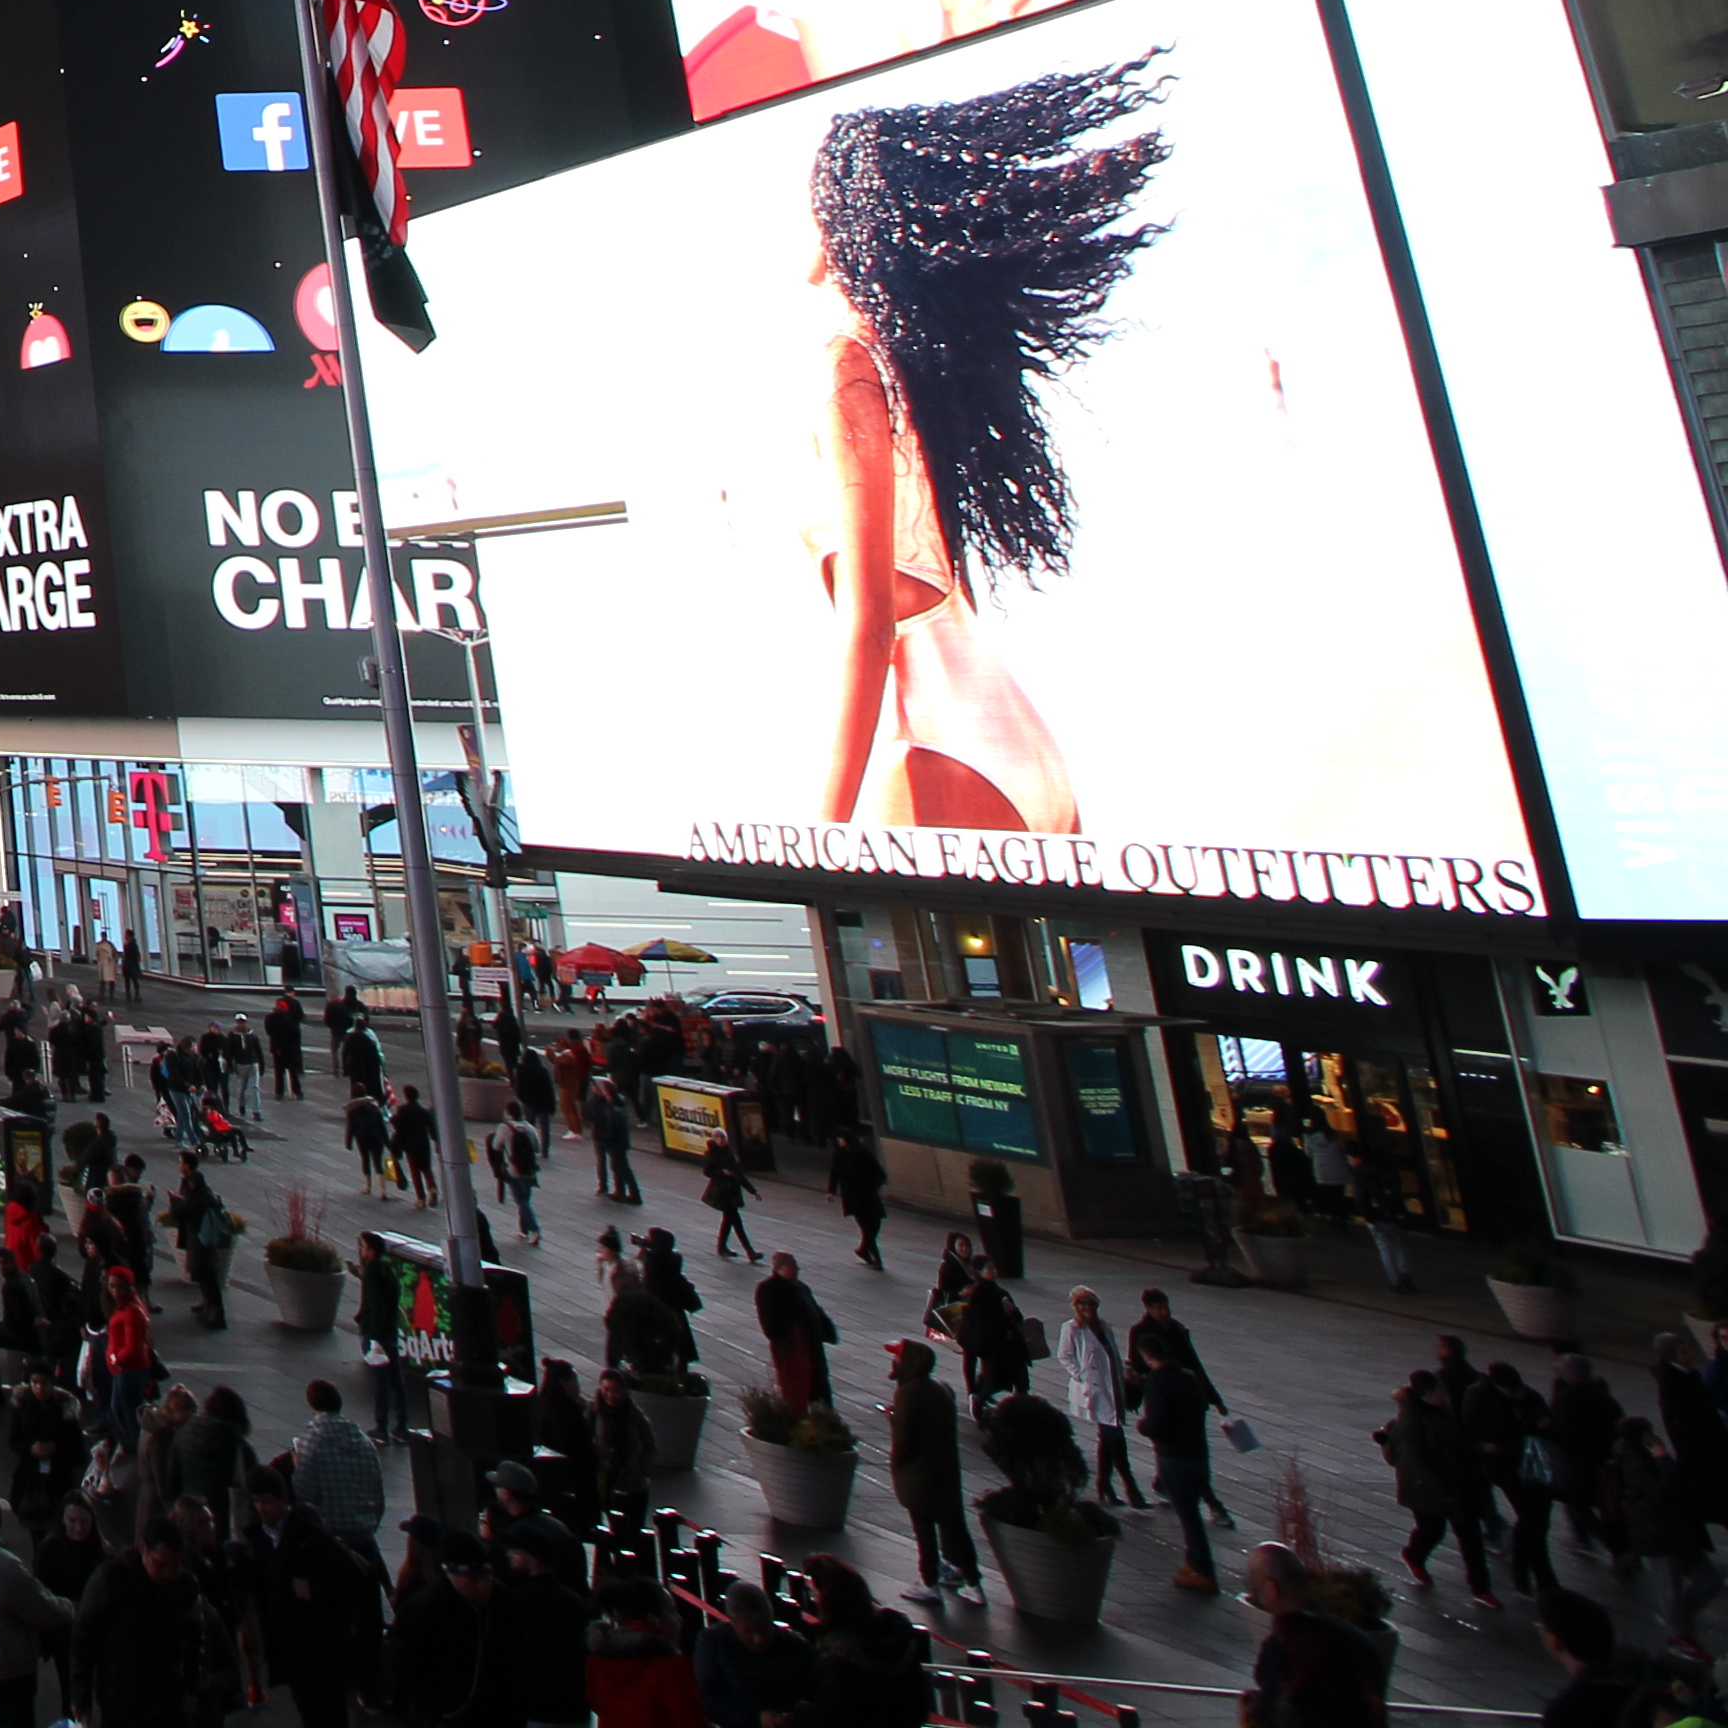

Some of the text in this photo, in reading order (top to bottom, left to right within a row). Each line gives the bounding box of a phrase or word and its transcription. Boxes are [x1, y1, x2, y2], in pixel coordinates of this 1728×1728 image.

[201, 488, 320, 550] NO
[211, 555, 489, 630] CHAR
[687, 820, 1548, 918] AMERICAN EAGLE OUTFITTERS
[1180, 943, 1391, 1006] DRINK
[974, 1042, 1008, 1054] UNITED
[882, 1063, 1026, 1097] MORE FLIGHTS FROM NEWARK,
[898, 1084, 923, 1098] LESS
[966, 1094, 994, 1110] FROM
[994, 1100, 1010, 1112] NY
[663, 1099, 720, 1129] Beautiful
